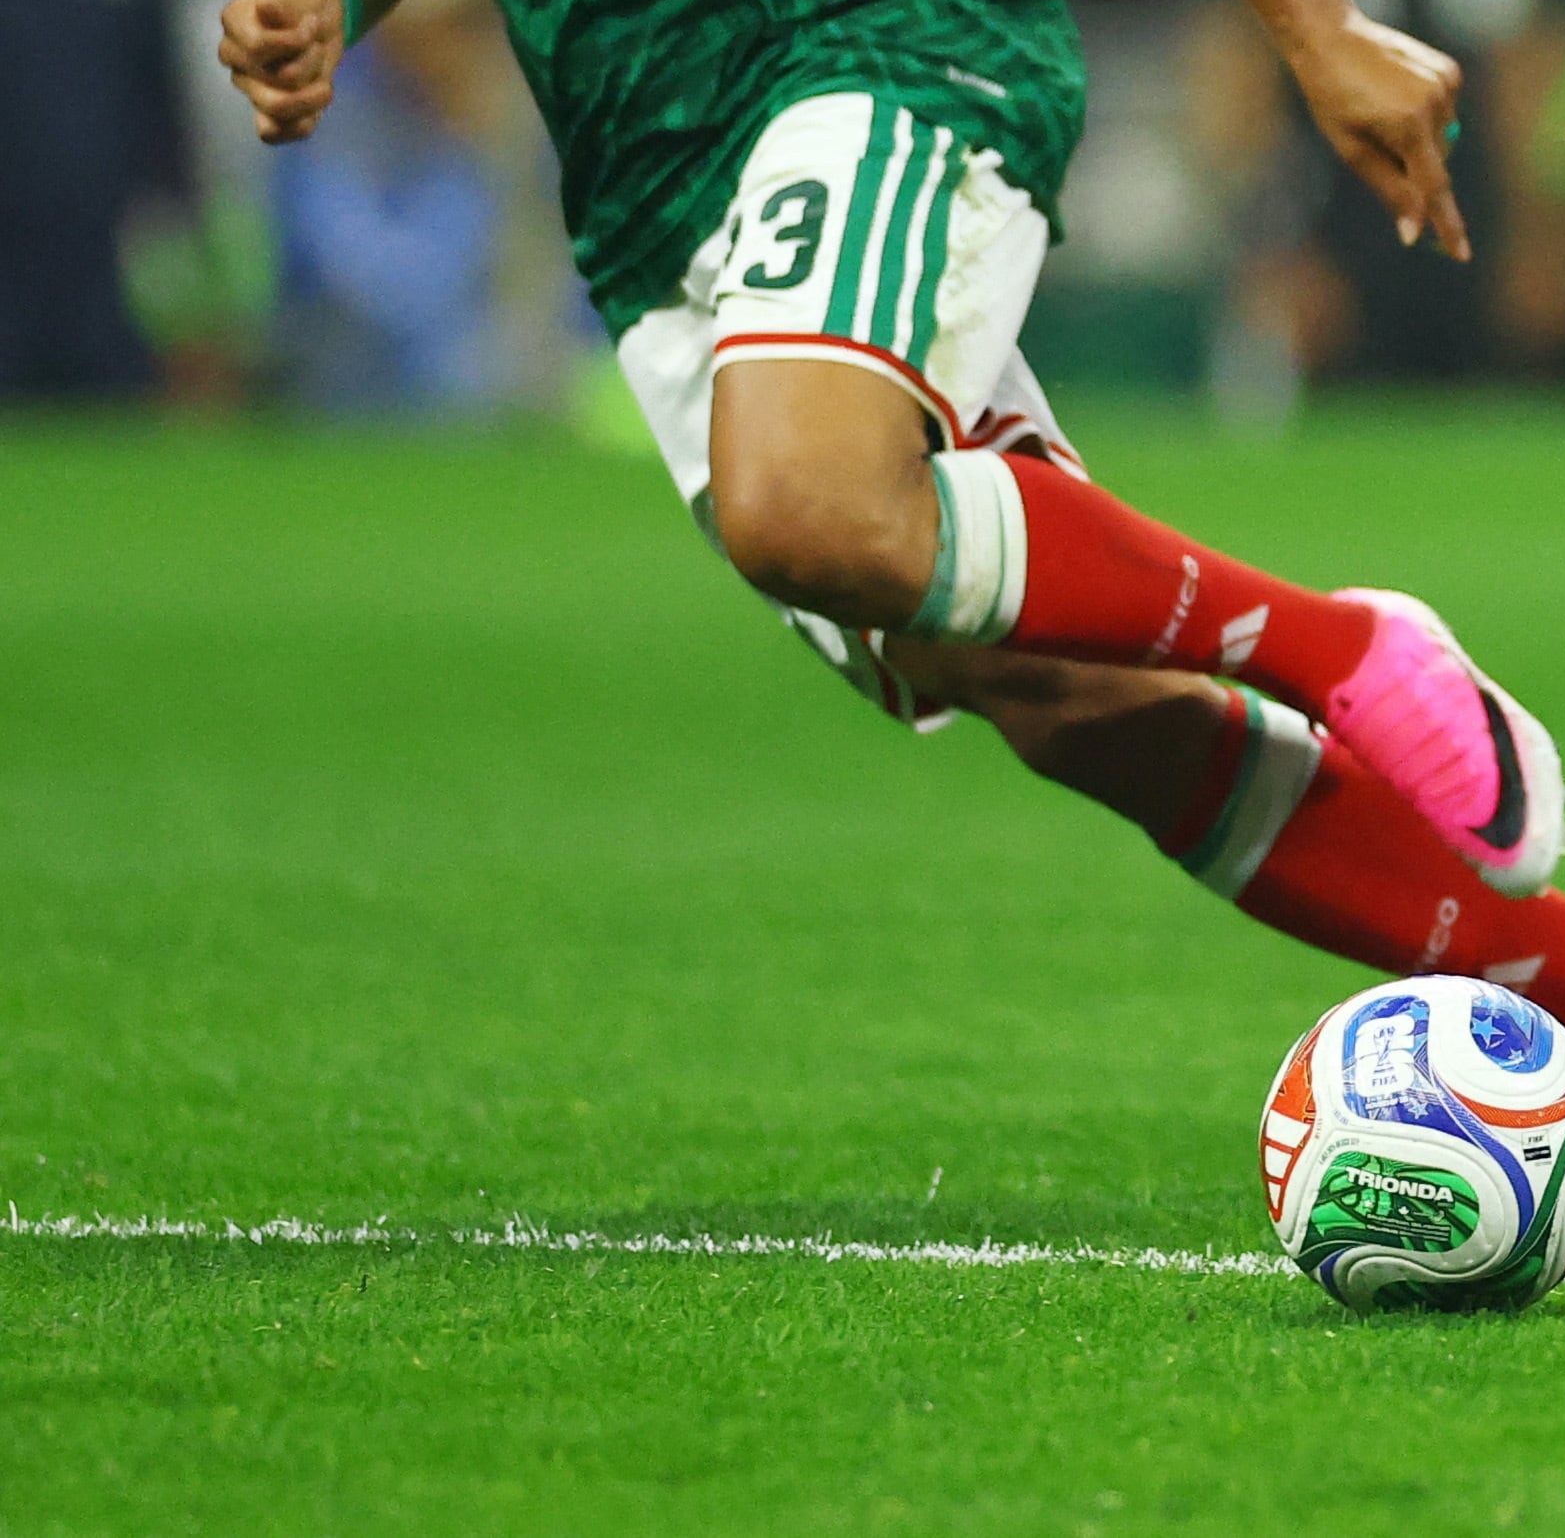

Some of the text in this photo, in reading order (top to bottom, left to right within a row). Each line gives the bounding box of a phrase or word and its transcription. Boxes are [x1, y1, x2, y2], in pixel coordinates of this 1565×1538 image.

[728, 179, 829, 290] 3
[1372, 1075, 1397, 1086] FIFA
[1345, 1166, 1454, 1203] TRIONDA
